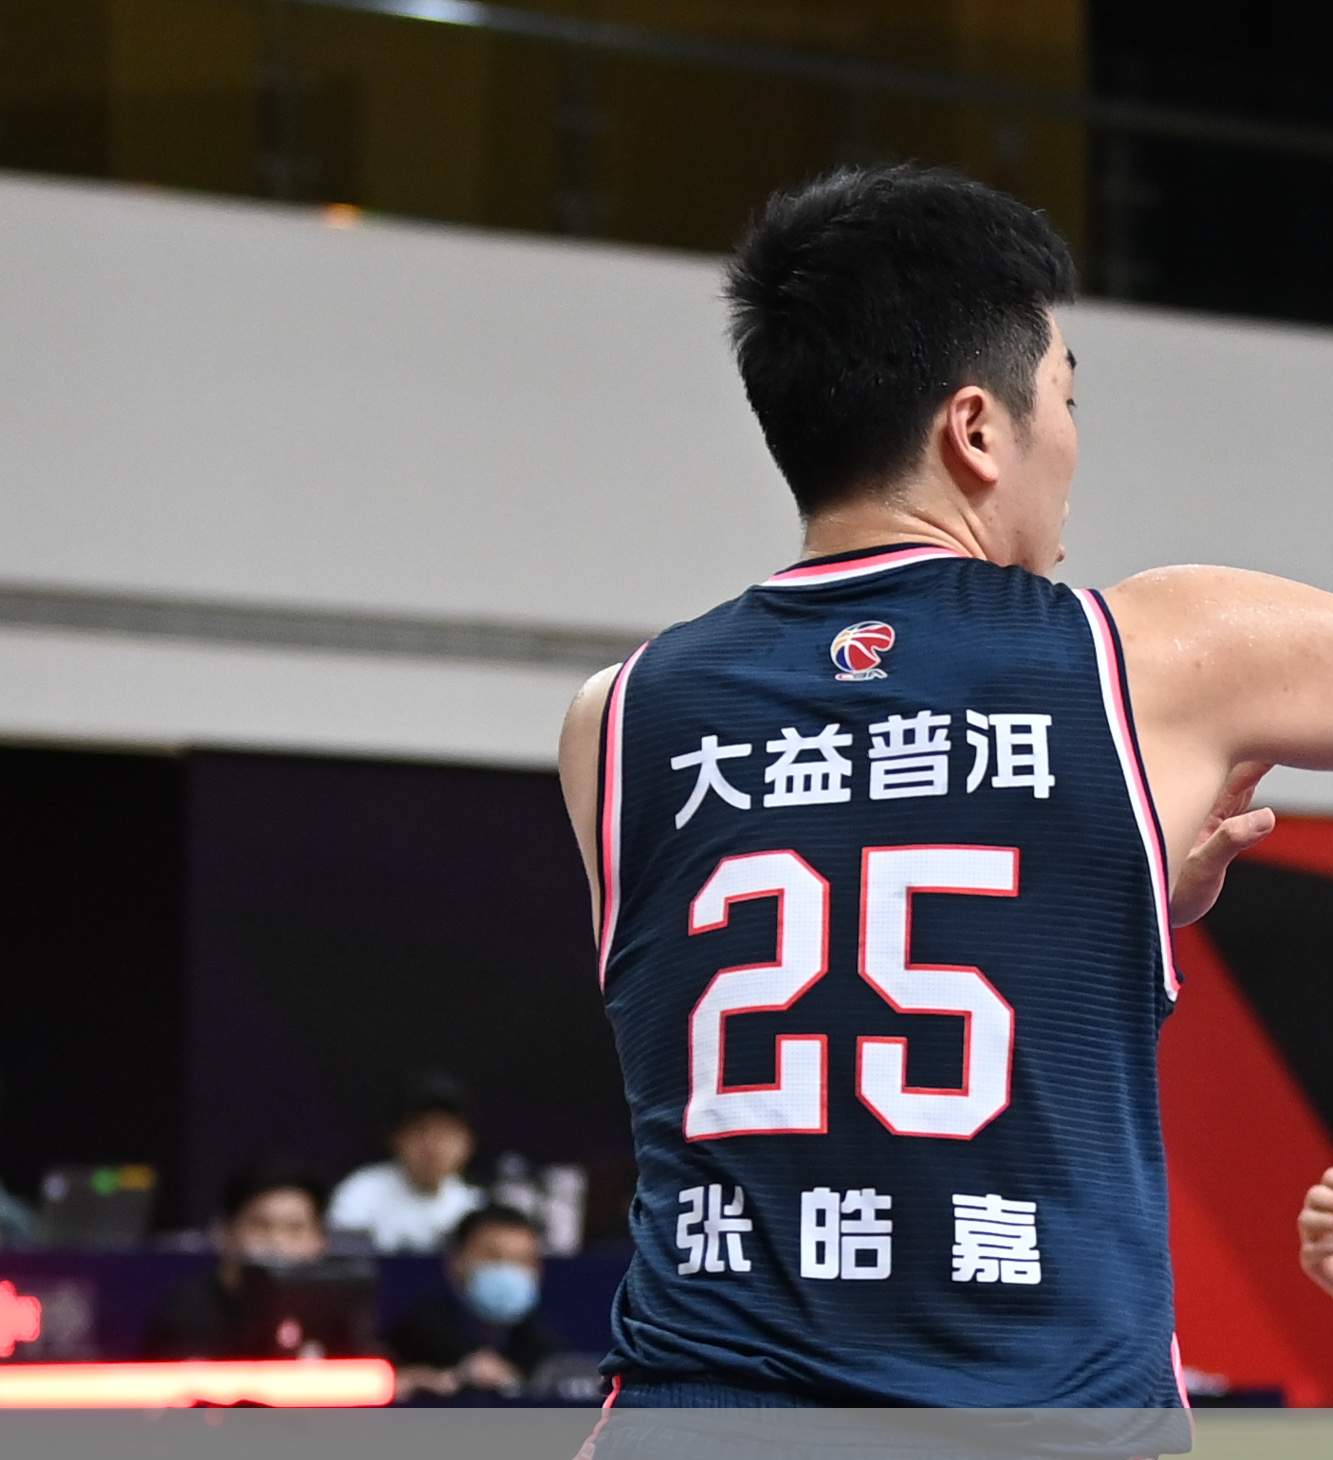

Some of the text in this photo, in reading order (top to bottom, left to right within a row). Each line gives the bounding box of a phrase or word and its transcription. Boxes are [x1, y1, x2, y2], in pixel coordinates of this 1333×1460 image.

[670, 709, 1056, 830] 大益普洱
[683, 846, 1020, 1140] 25
[675, 1184, 1043, 1285] 张皓嘉
